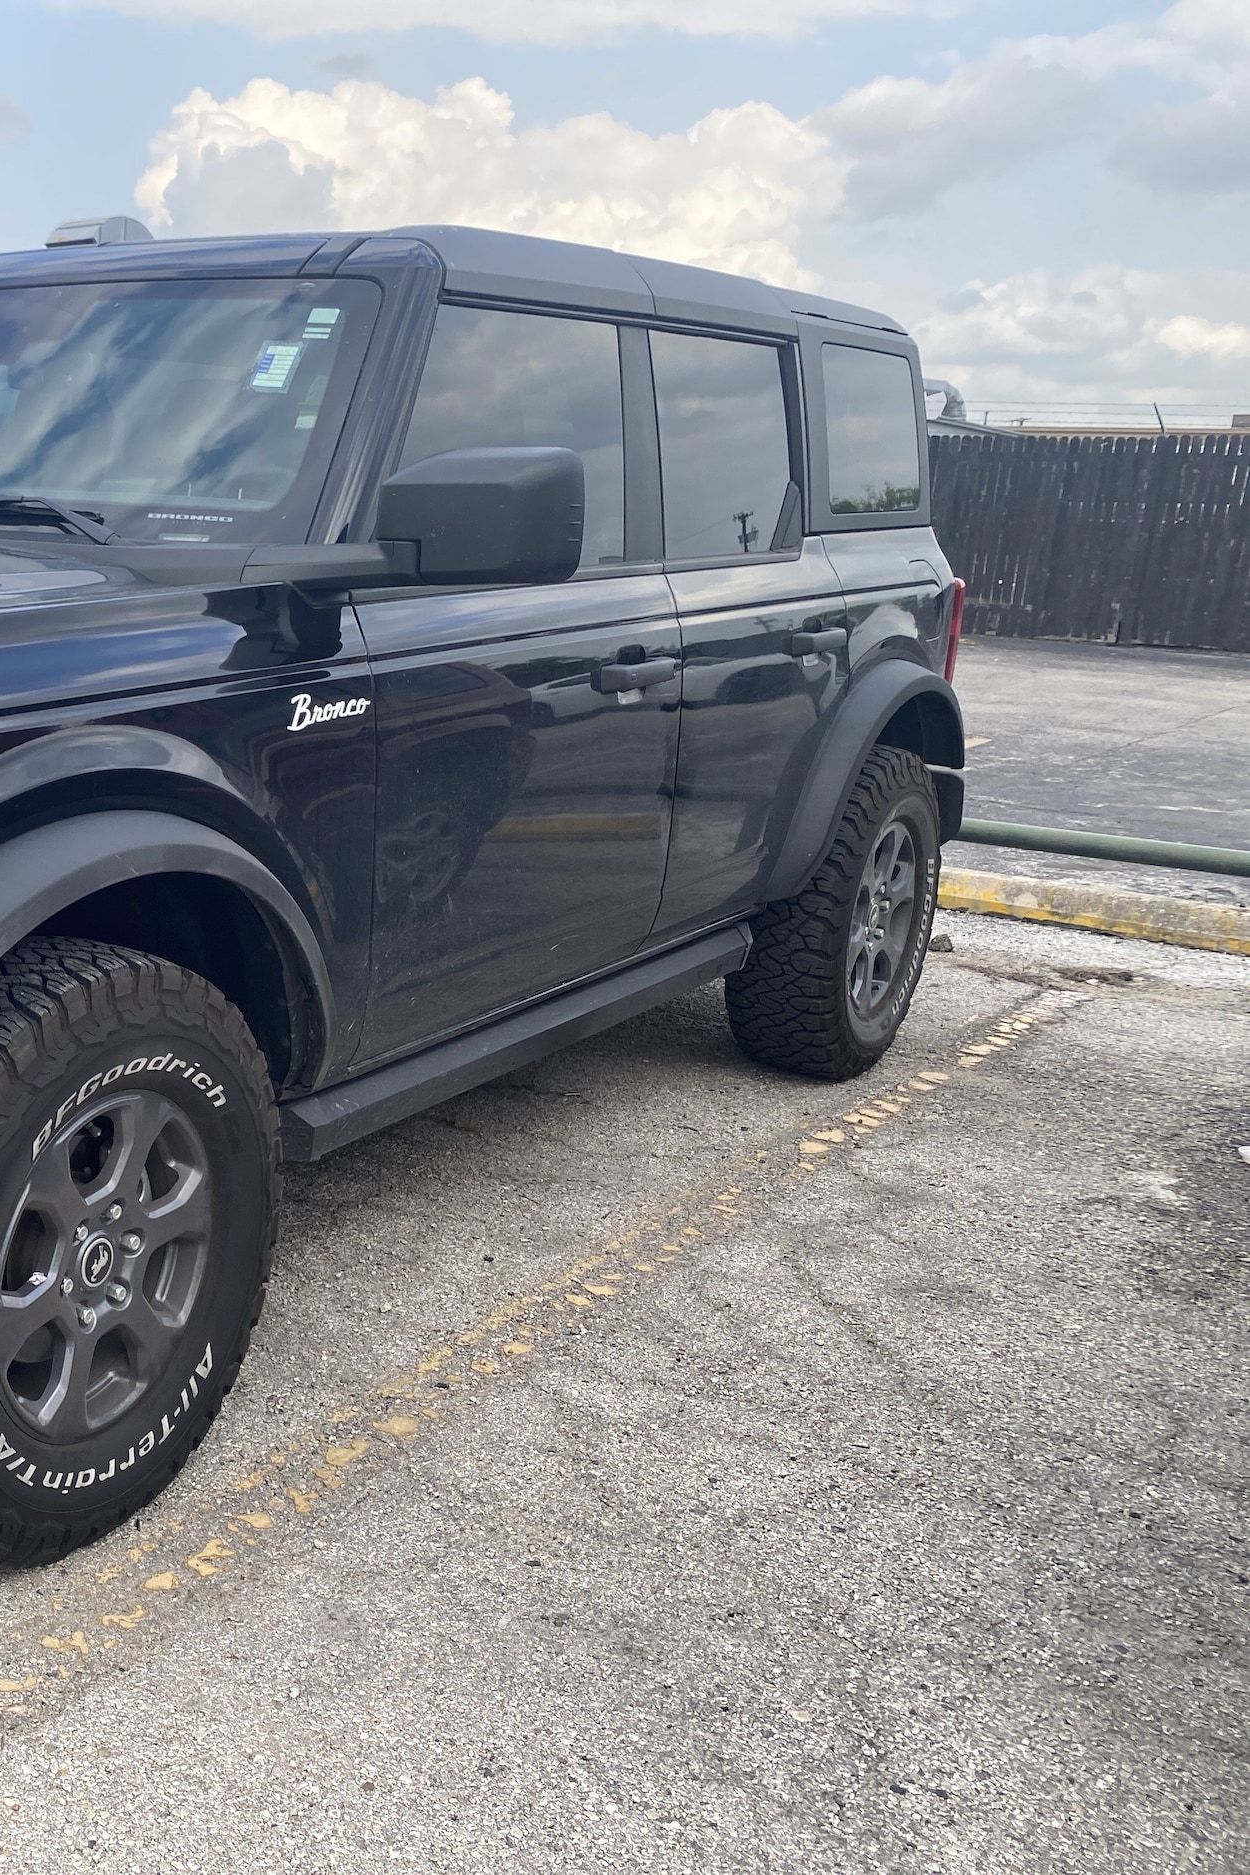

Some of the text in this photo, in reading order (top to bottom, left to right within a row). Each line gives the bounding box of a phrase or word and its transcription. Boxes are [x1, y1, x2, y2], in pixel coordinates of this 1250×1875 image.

[147, 512, 234, 523] BRONCO
[286, 693, 371, 732] Bronco
[891, 858, 935, 1016] BFGoodrich
[32, 1052, 228, 1162] BFGoodrich
[41, 1342, 214, 1495] All-Terrain
